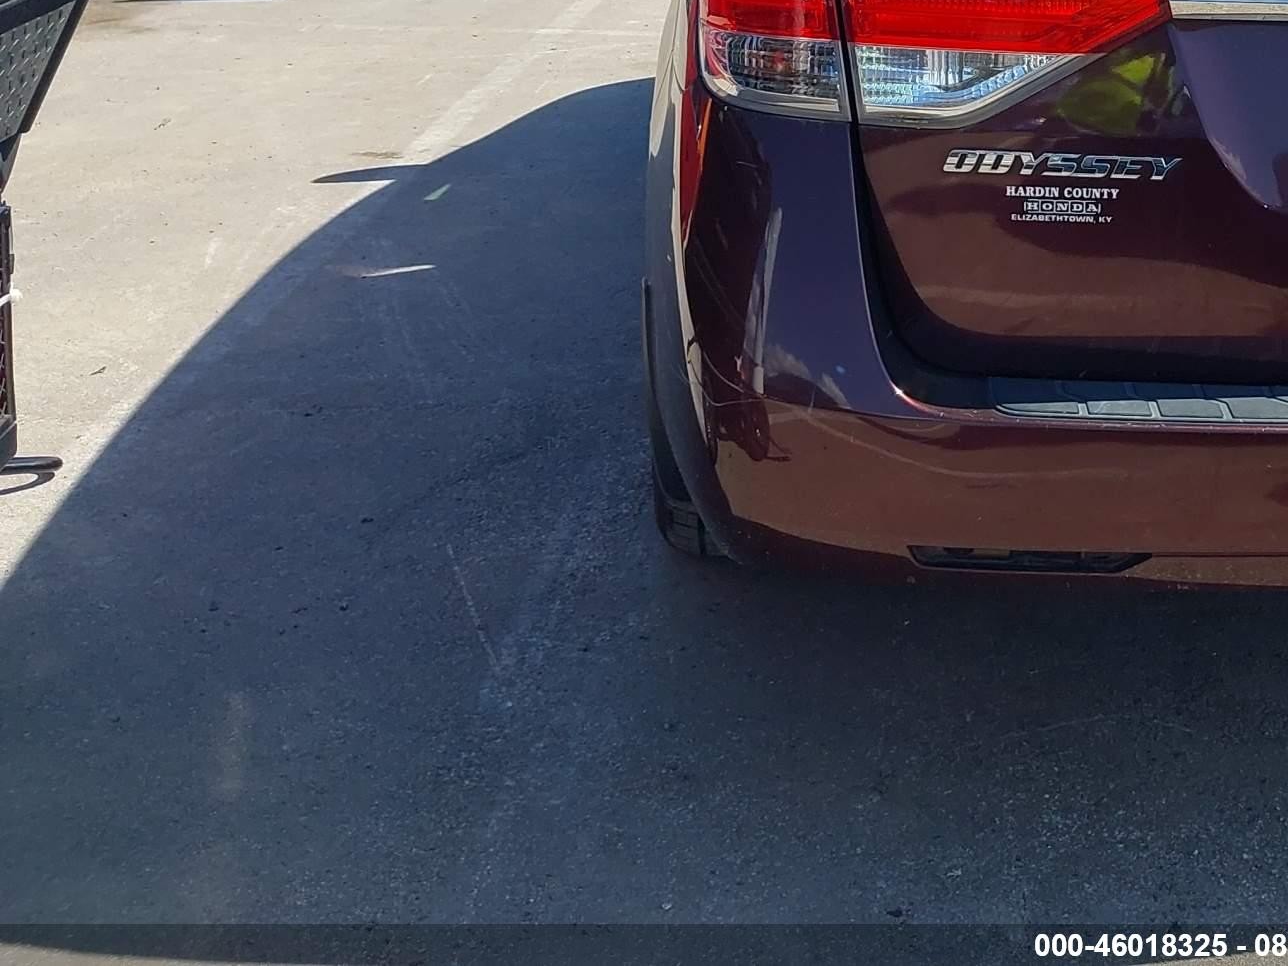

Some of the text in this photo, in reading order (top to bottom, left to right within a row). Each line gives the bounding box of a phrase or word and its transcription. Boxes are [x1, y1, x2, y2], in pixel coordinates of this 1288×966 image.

[943, 149, 1183, 180] ODYSSEY
[1005, 185, 1120, 199] HARDIN COUNTY
[1026, 201, 1099, 213] HONDA
[1011, 214, 1096, 224] ELIZABETHTOWN,
